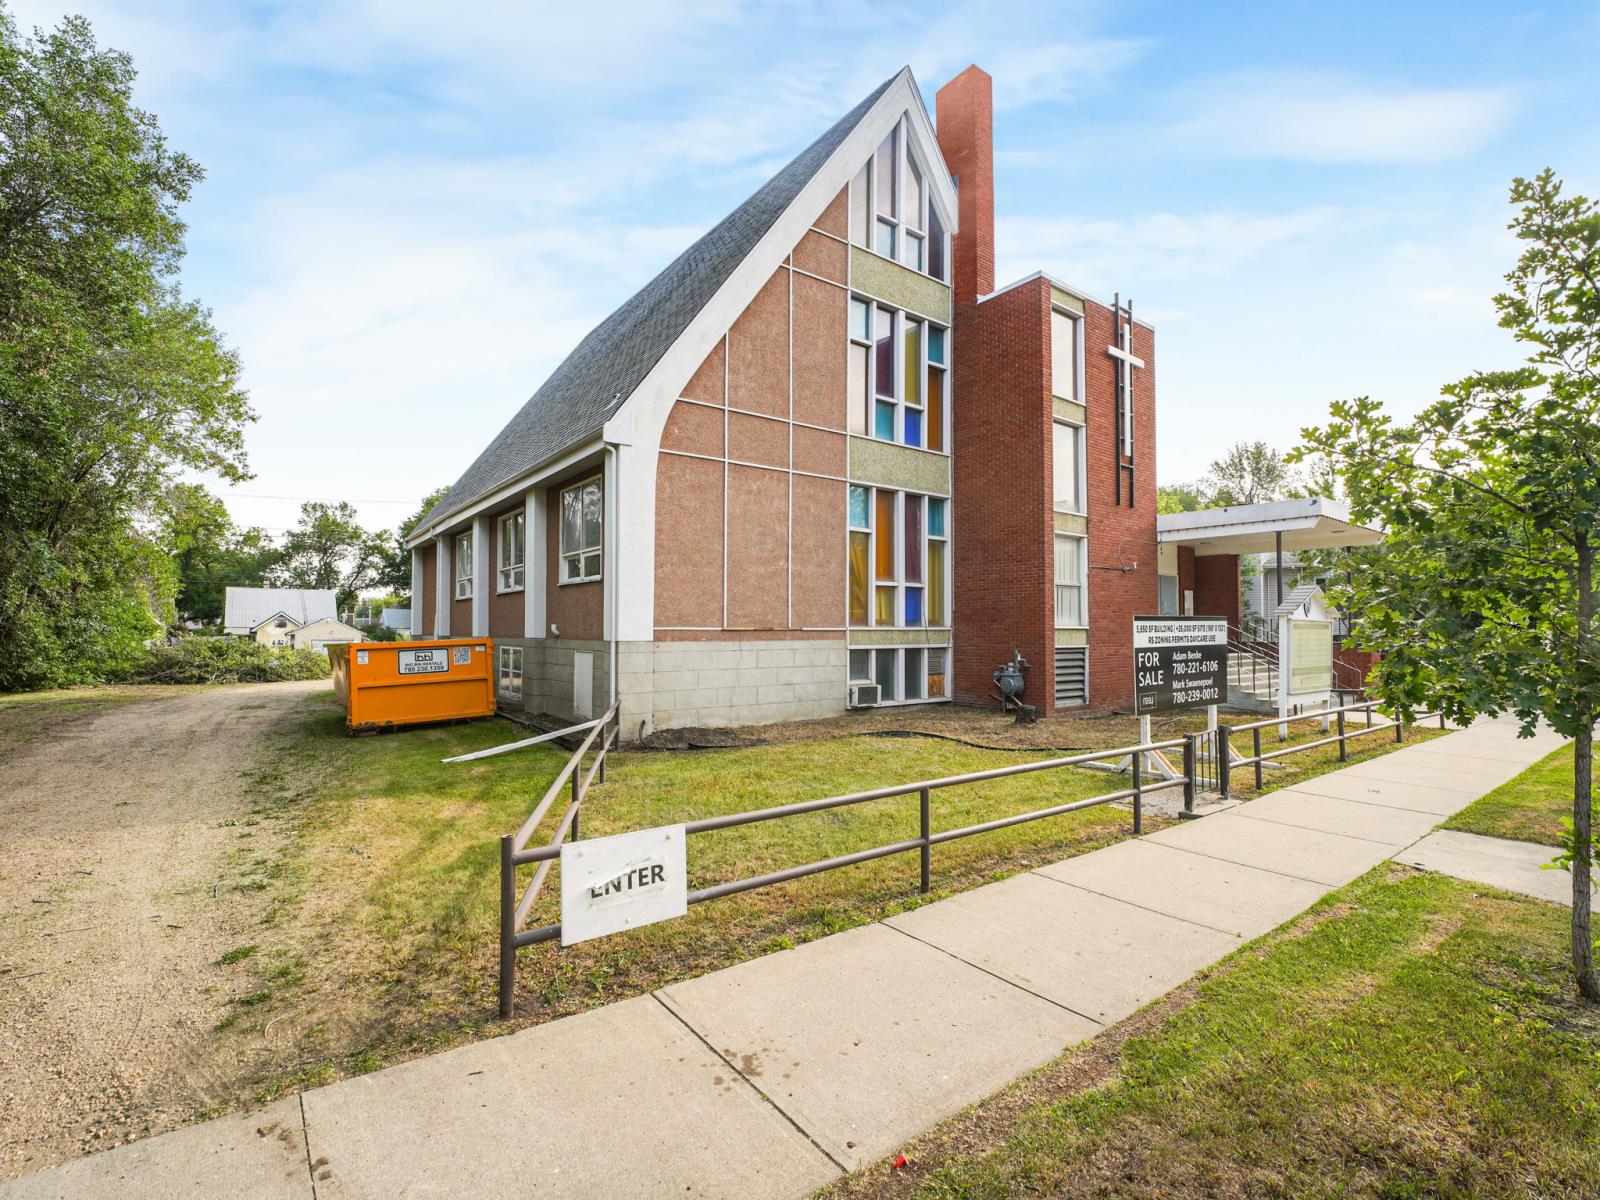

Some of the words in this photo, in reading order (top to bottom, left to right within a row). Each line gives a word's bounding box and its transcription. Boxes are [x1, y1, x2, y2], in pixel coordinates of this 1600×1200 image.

[1154, 624, 1173, 633] BUILDING
[1197, 624, 1206, 632] SITE
[1154, 635, 1171, 644] ZONING
[1172, 635, 1189, 644] PERMITS
[1190, 634, 1208, 643] DAYCARE
[1208, 634, 1216, 642] USE
[1138, 652, 1160, 668] FOR
[1172, 651, 1187, 660] Adam
[1188, 651, 1202, 660] Benke
[1172, 660, 1219, 675] 780-221-6106
[1138, 670, 1164, 687] SALE
[1172, 680, 1185, 689] Mark
[1172, 687, 1219, 704] 780-239-0012
[590, 864, 665, 899] ENTER
